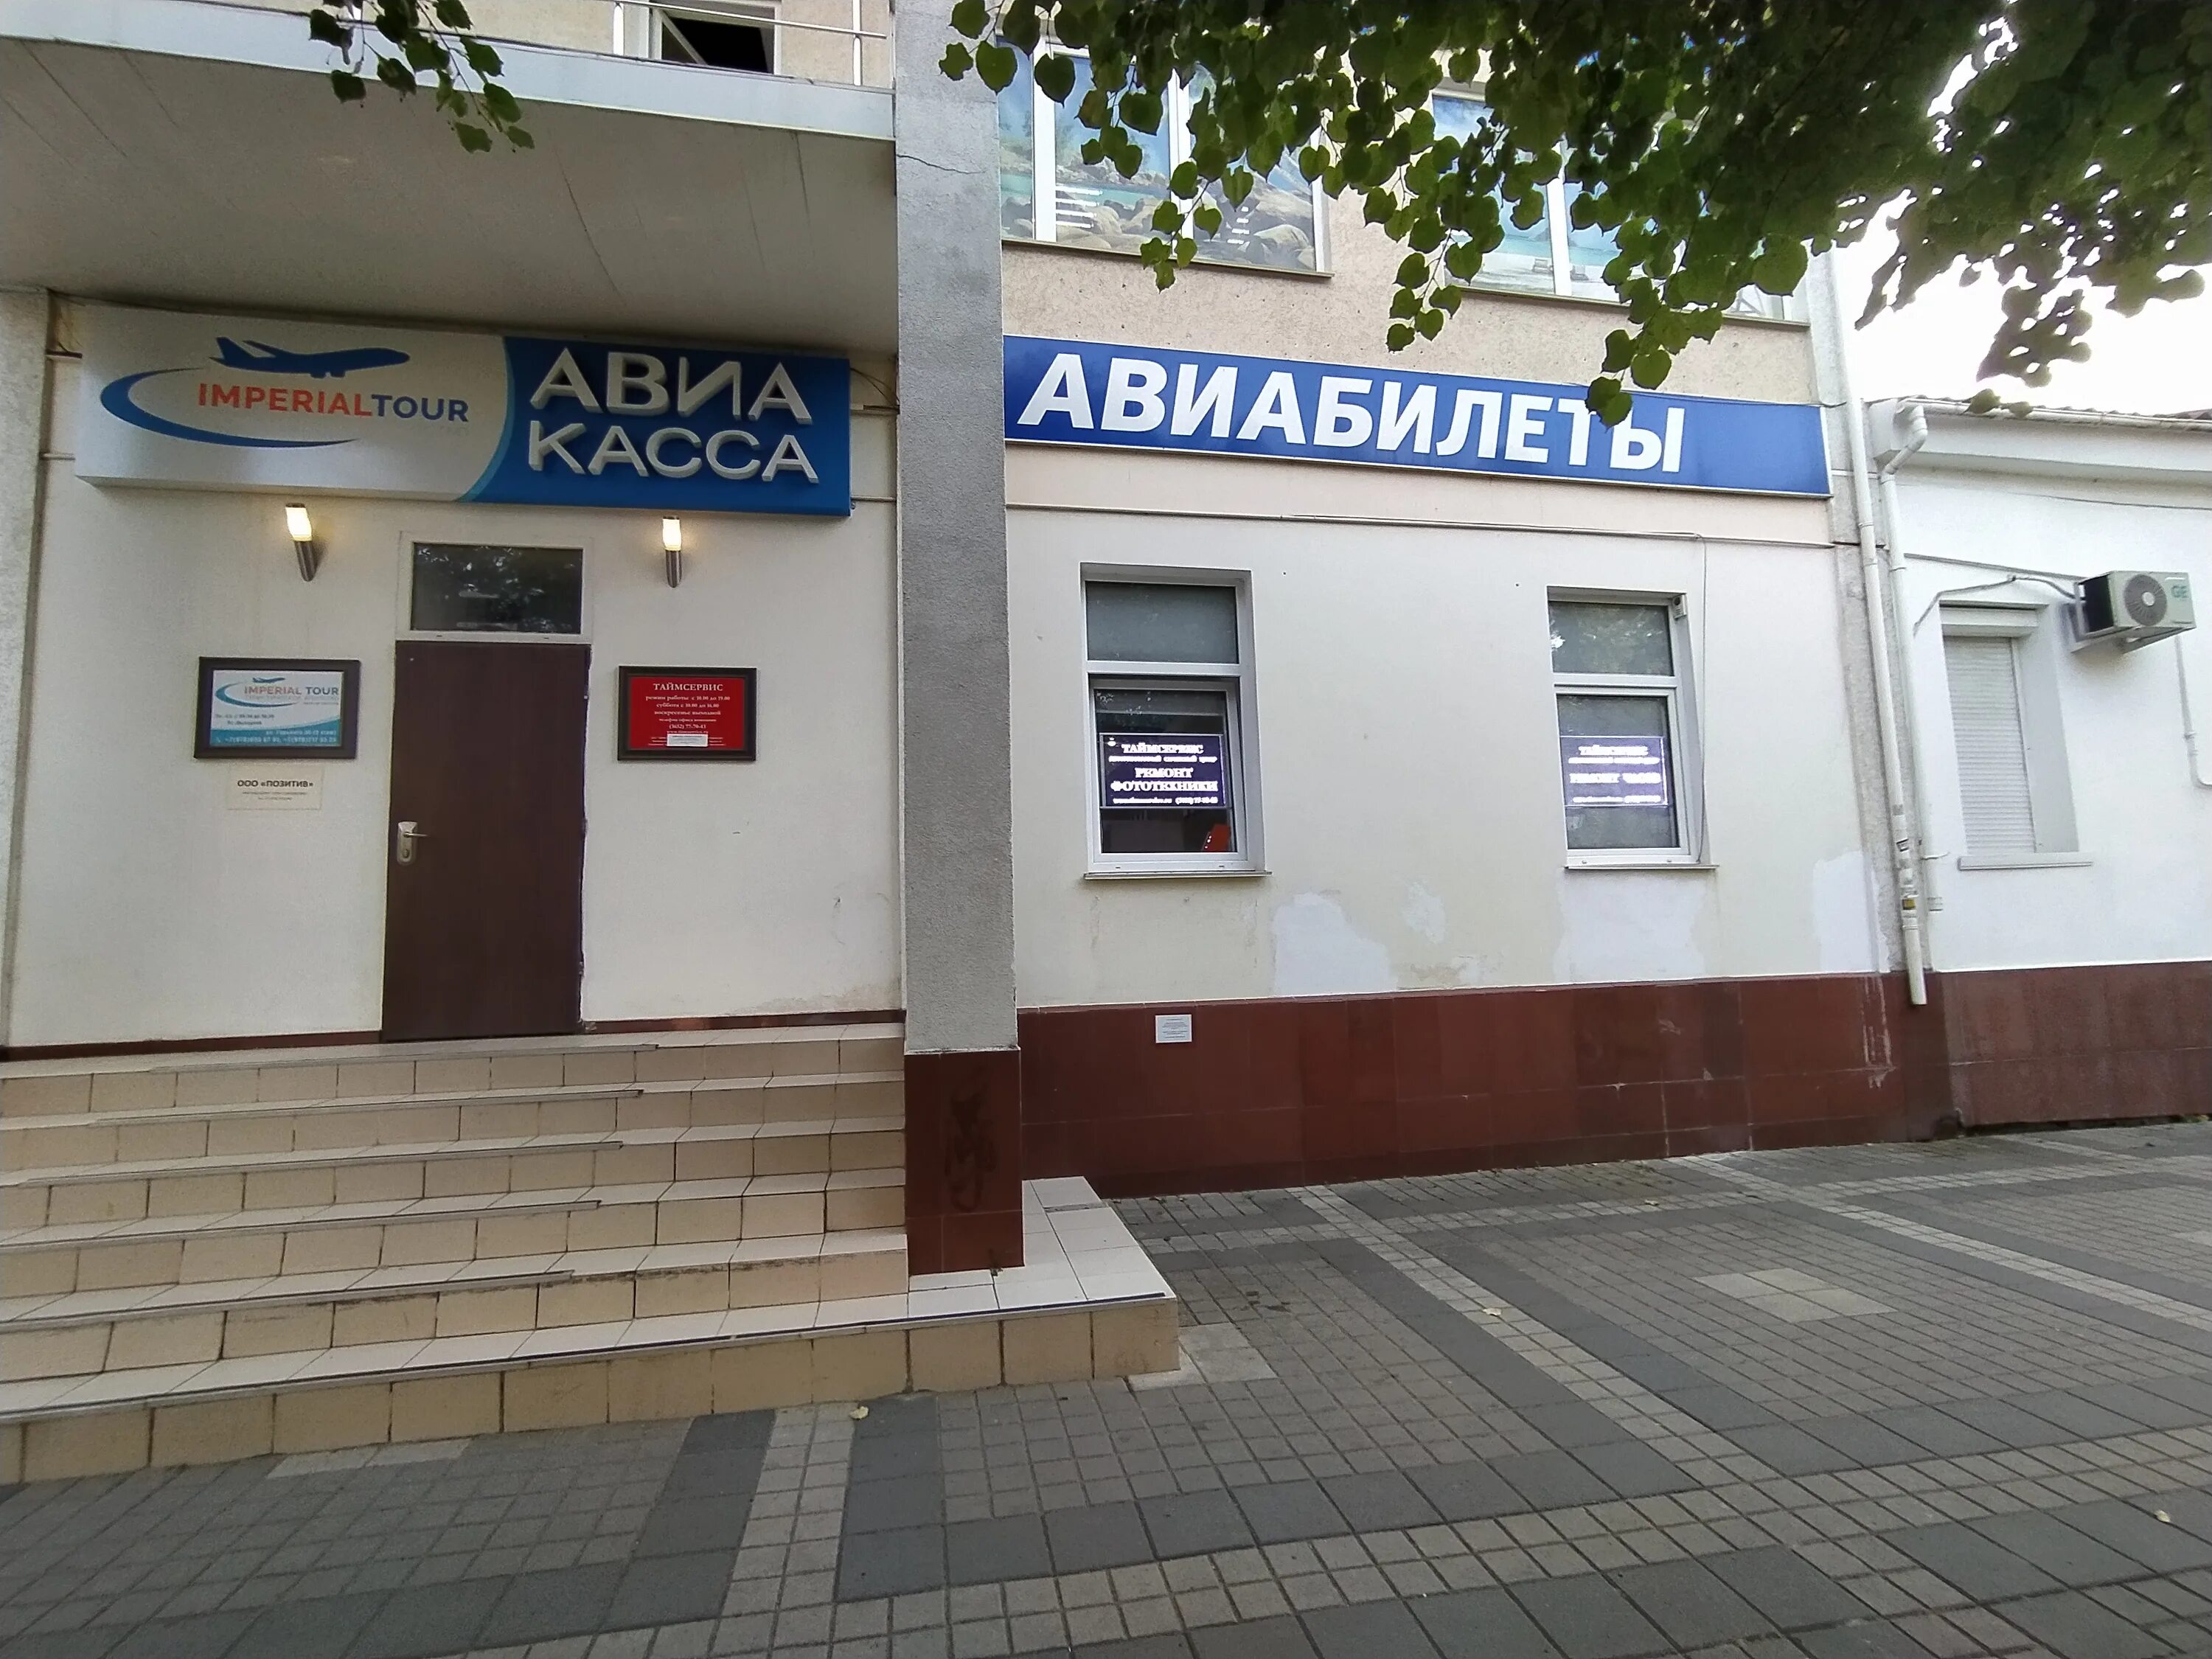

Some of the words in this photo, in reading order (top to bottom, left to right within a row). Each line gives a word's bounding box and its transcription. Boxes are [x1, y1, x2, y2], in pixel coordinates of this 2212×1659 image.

[529, 347, 812, 425] АВИА
[1017, 352, 1686, 474] АВИАБИЛЕТЫ
[528, 420, 819, 484] КАССА
[244, 686, 302, 695] IMPERIAL
[305, 686, 339, 695] TOUR
[653, 682, 723, 692] ТАЙМСЕРВИС
